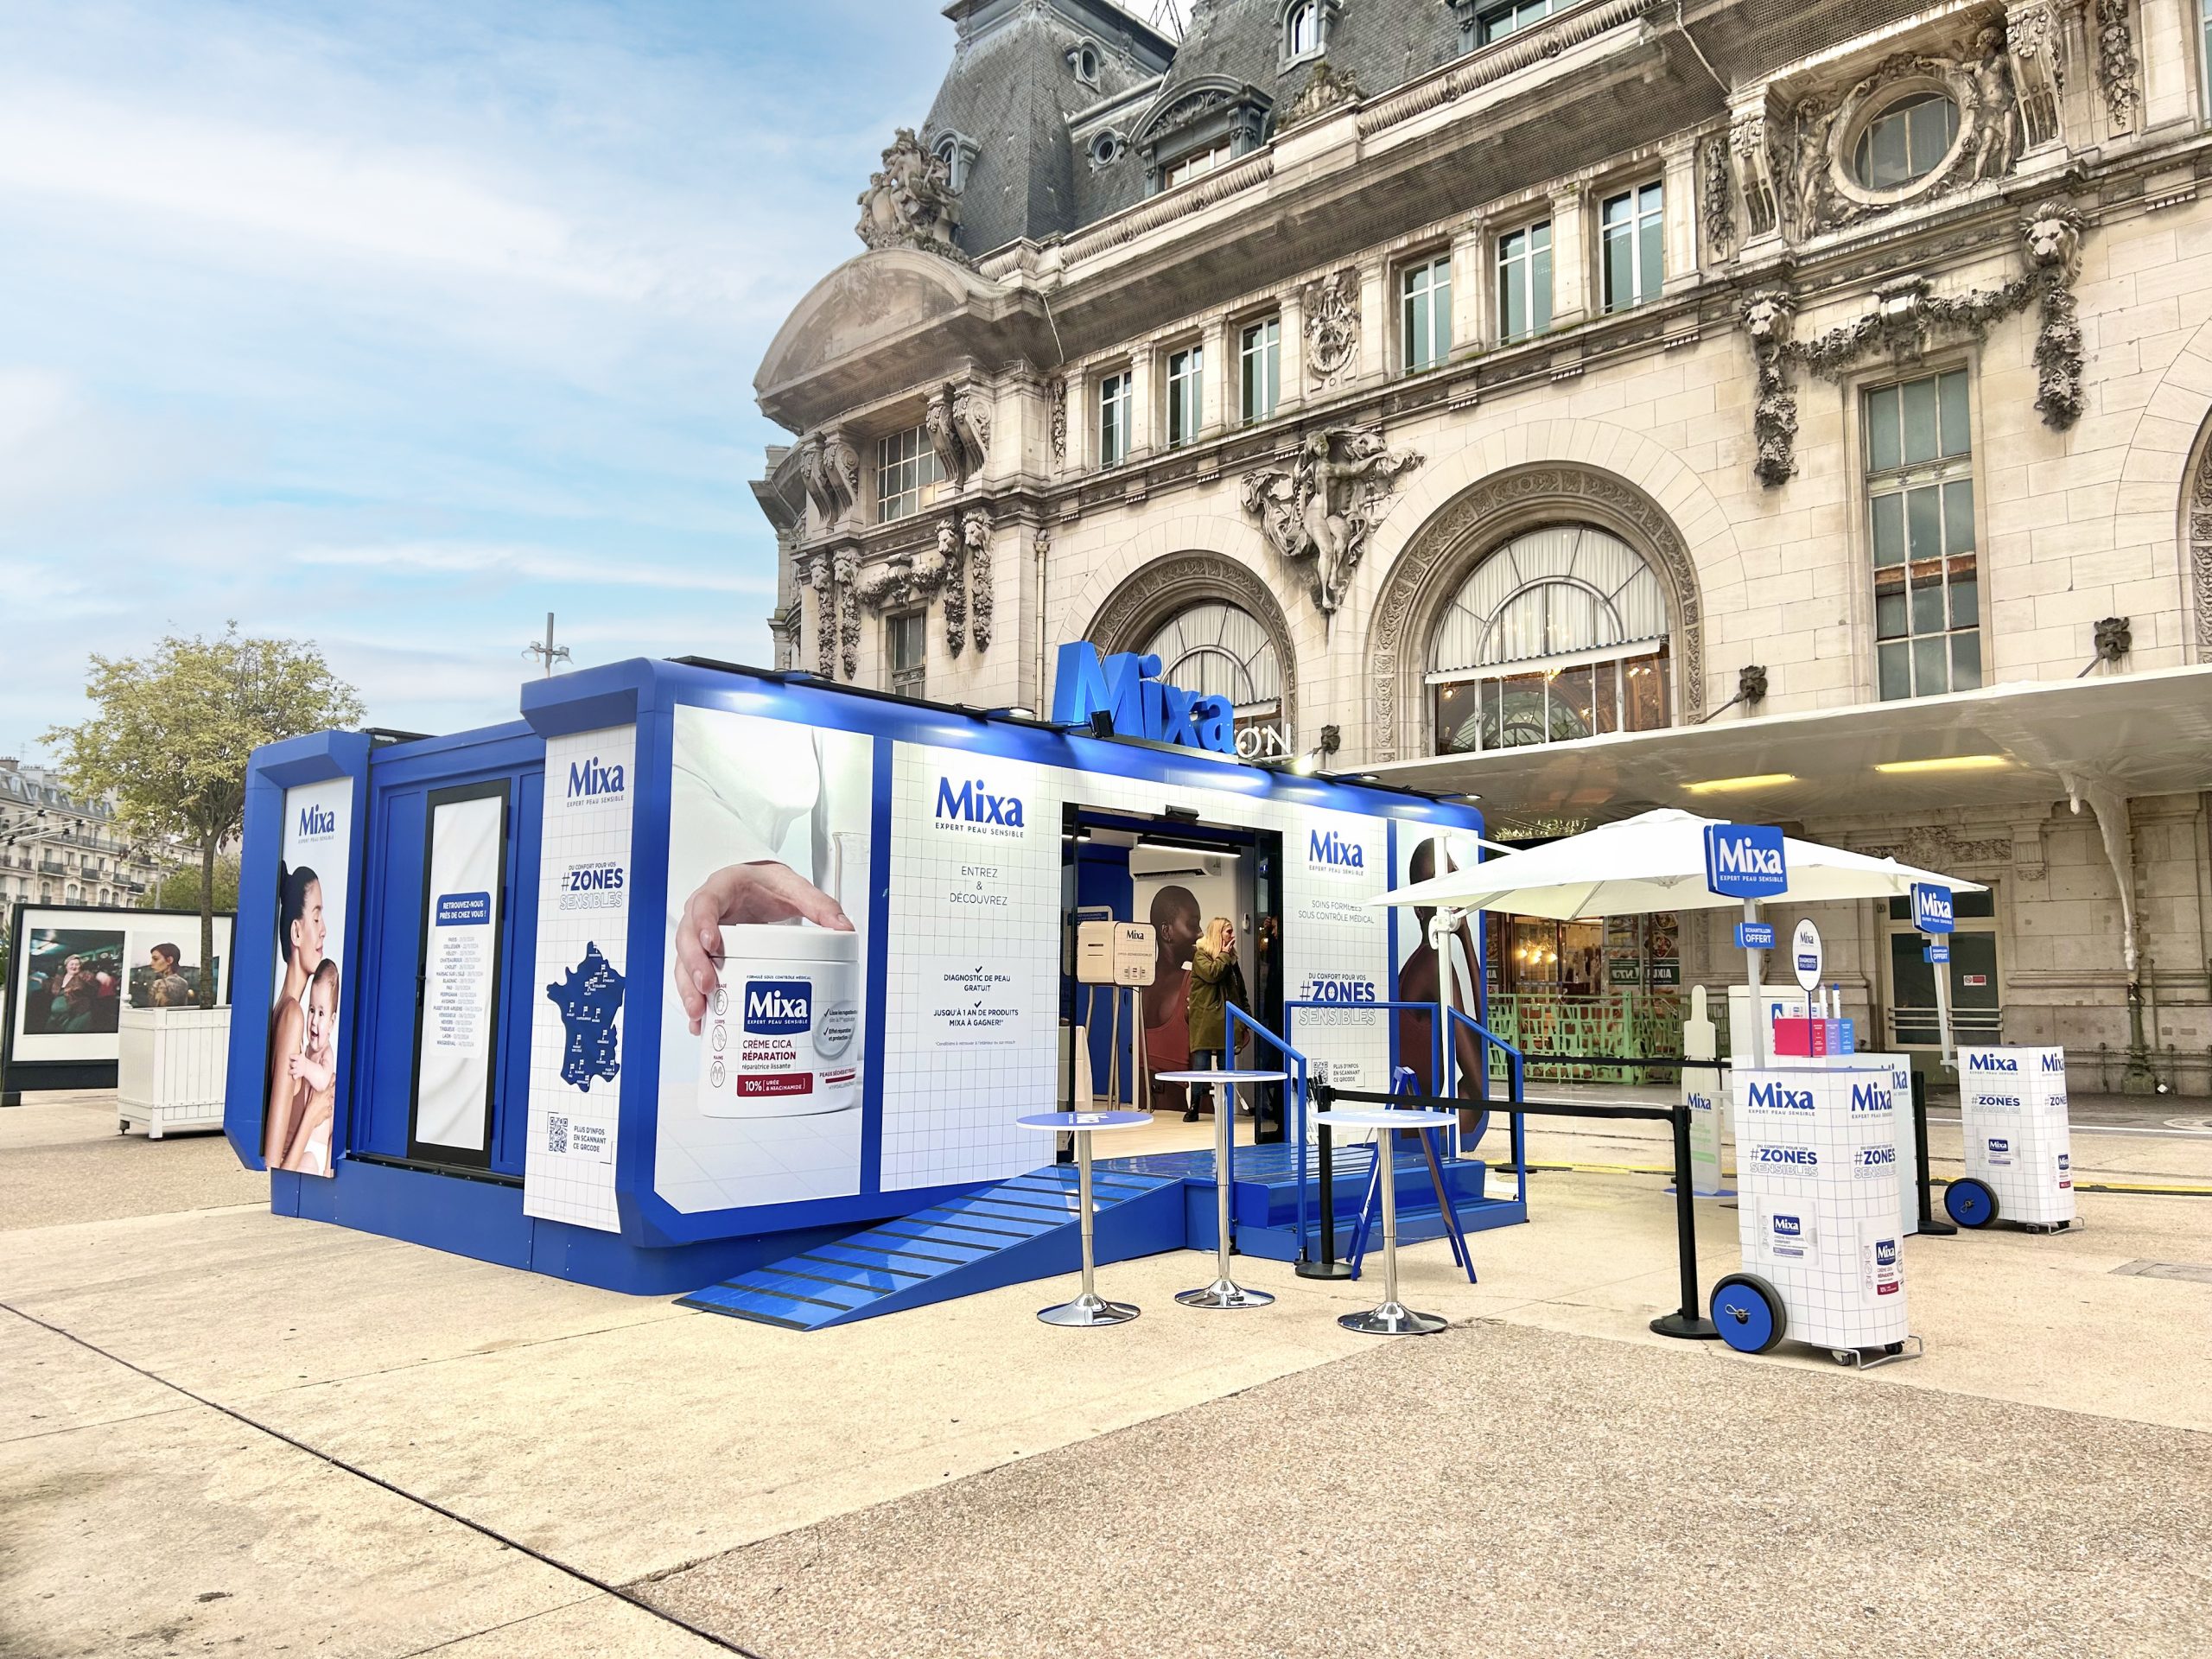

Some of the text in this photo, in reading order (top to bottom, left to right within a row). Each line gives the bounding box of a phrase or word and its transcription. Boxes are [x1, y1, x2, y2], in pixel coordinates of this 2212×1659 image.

[1052, 640, 1236, 754] Mixa
[1235, 723, 1291, 759] ON
[567, 756, 625, 798] Mixa
[601, 795, 624, 804] SENSIBLE
[936, 776, 1025, 828] Mixa
[299, 804, 334, 836] Mixa
[935, 822, 1024, 838] EXPERT PEAU SENSIBLE
[1309, 829, 1364, 868] Mixa
[1719, 837, 1783, 874] Mixa
[961, 866, 998, 878] ENTREZ
[562, 868, 624, 892] #ZONES
[976, 880, 982, 891] &
[442, 900, 484, 909] RETROUVEZ-NOUS
[560, 891, 623, 910] SENSIBLES
[950, 891, 1007, 906] DÉCOUVREZ
[1312, 900, 1330, 909] SOINS
[1921, 892, 1952, 919] Mixa
[439, 911, 450, 919] PRÈS
[1299, 911, 1375, 924] SOUS CONTRÔLE MÉDICAL
[1126, 930, 1144, 940] Mixa
[1745, 934, 1771, 944] OFFERT
[1800, 931, 1814, 944] Mixa
[1300, 980, 1376, 1002] #ZONES
[747, 989, 808, 1021] Mixa
[933, 1007, 962, 1016] JUSQU'À
[1299, 1007, 1376, 1026] SENSIBLES
[742, 1039, 791, 1049] CRÈME CICA
[742, 1051, 796, 1061] RÉPARATION
[1970, 1053, 2018, 1071] Mixa
[745, 1080, 762, 1092] 10%
[1688, 1092, 1712, 1110] Mixa
[1748, 1082, 1815, 1109] Mixa
[1851, 1081, 1892, 1111] Mixa
[1971, 1096, 2020, 1107] #ZONES
[2044, 1096, 2067, 1107] #ZONE
[587, 1127, 605, 1135] D'INFOS
[581, 1135, 607, 1144] SCANNANT
[1750, 1147, 1818, 1165] #ZONES
[1854, 1148, 1896, 1166] #ZONES
[1750, 1162, 1819, 1177] SENSIBLES
[1775, 1218, 1799, 1230] Mixa
[1878, 1245, 1895, 1259] Mixa
